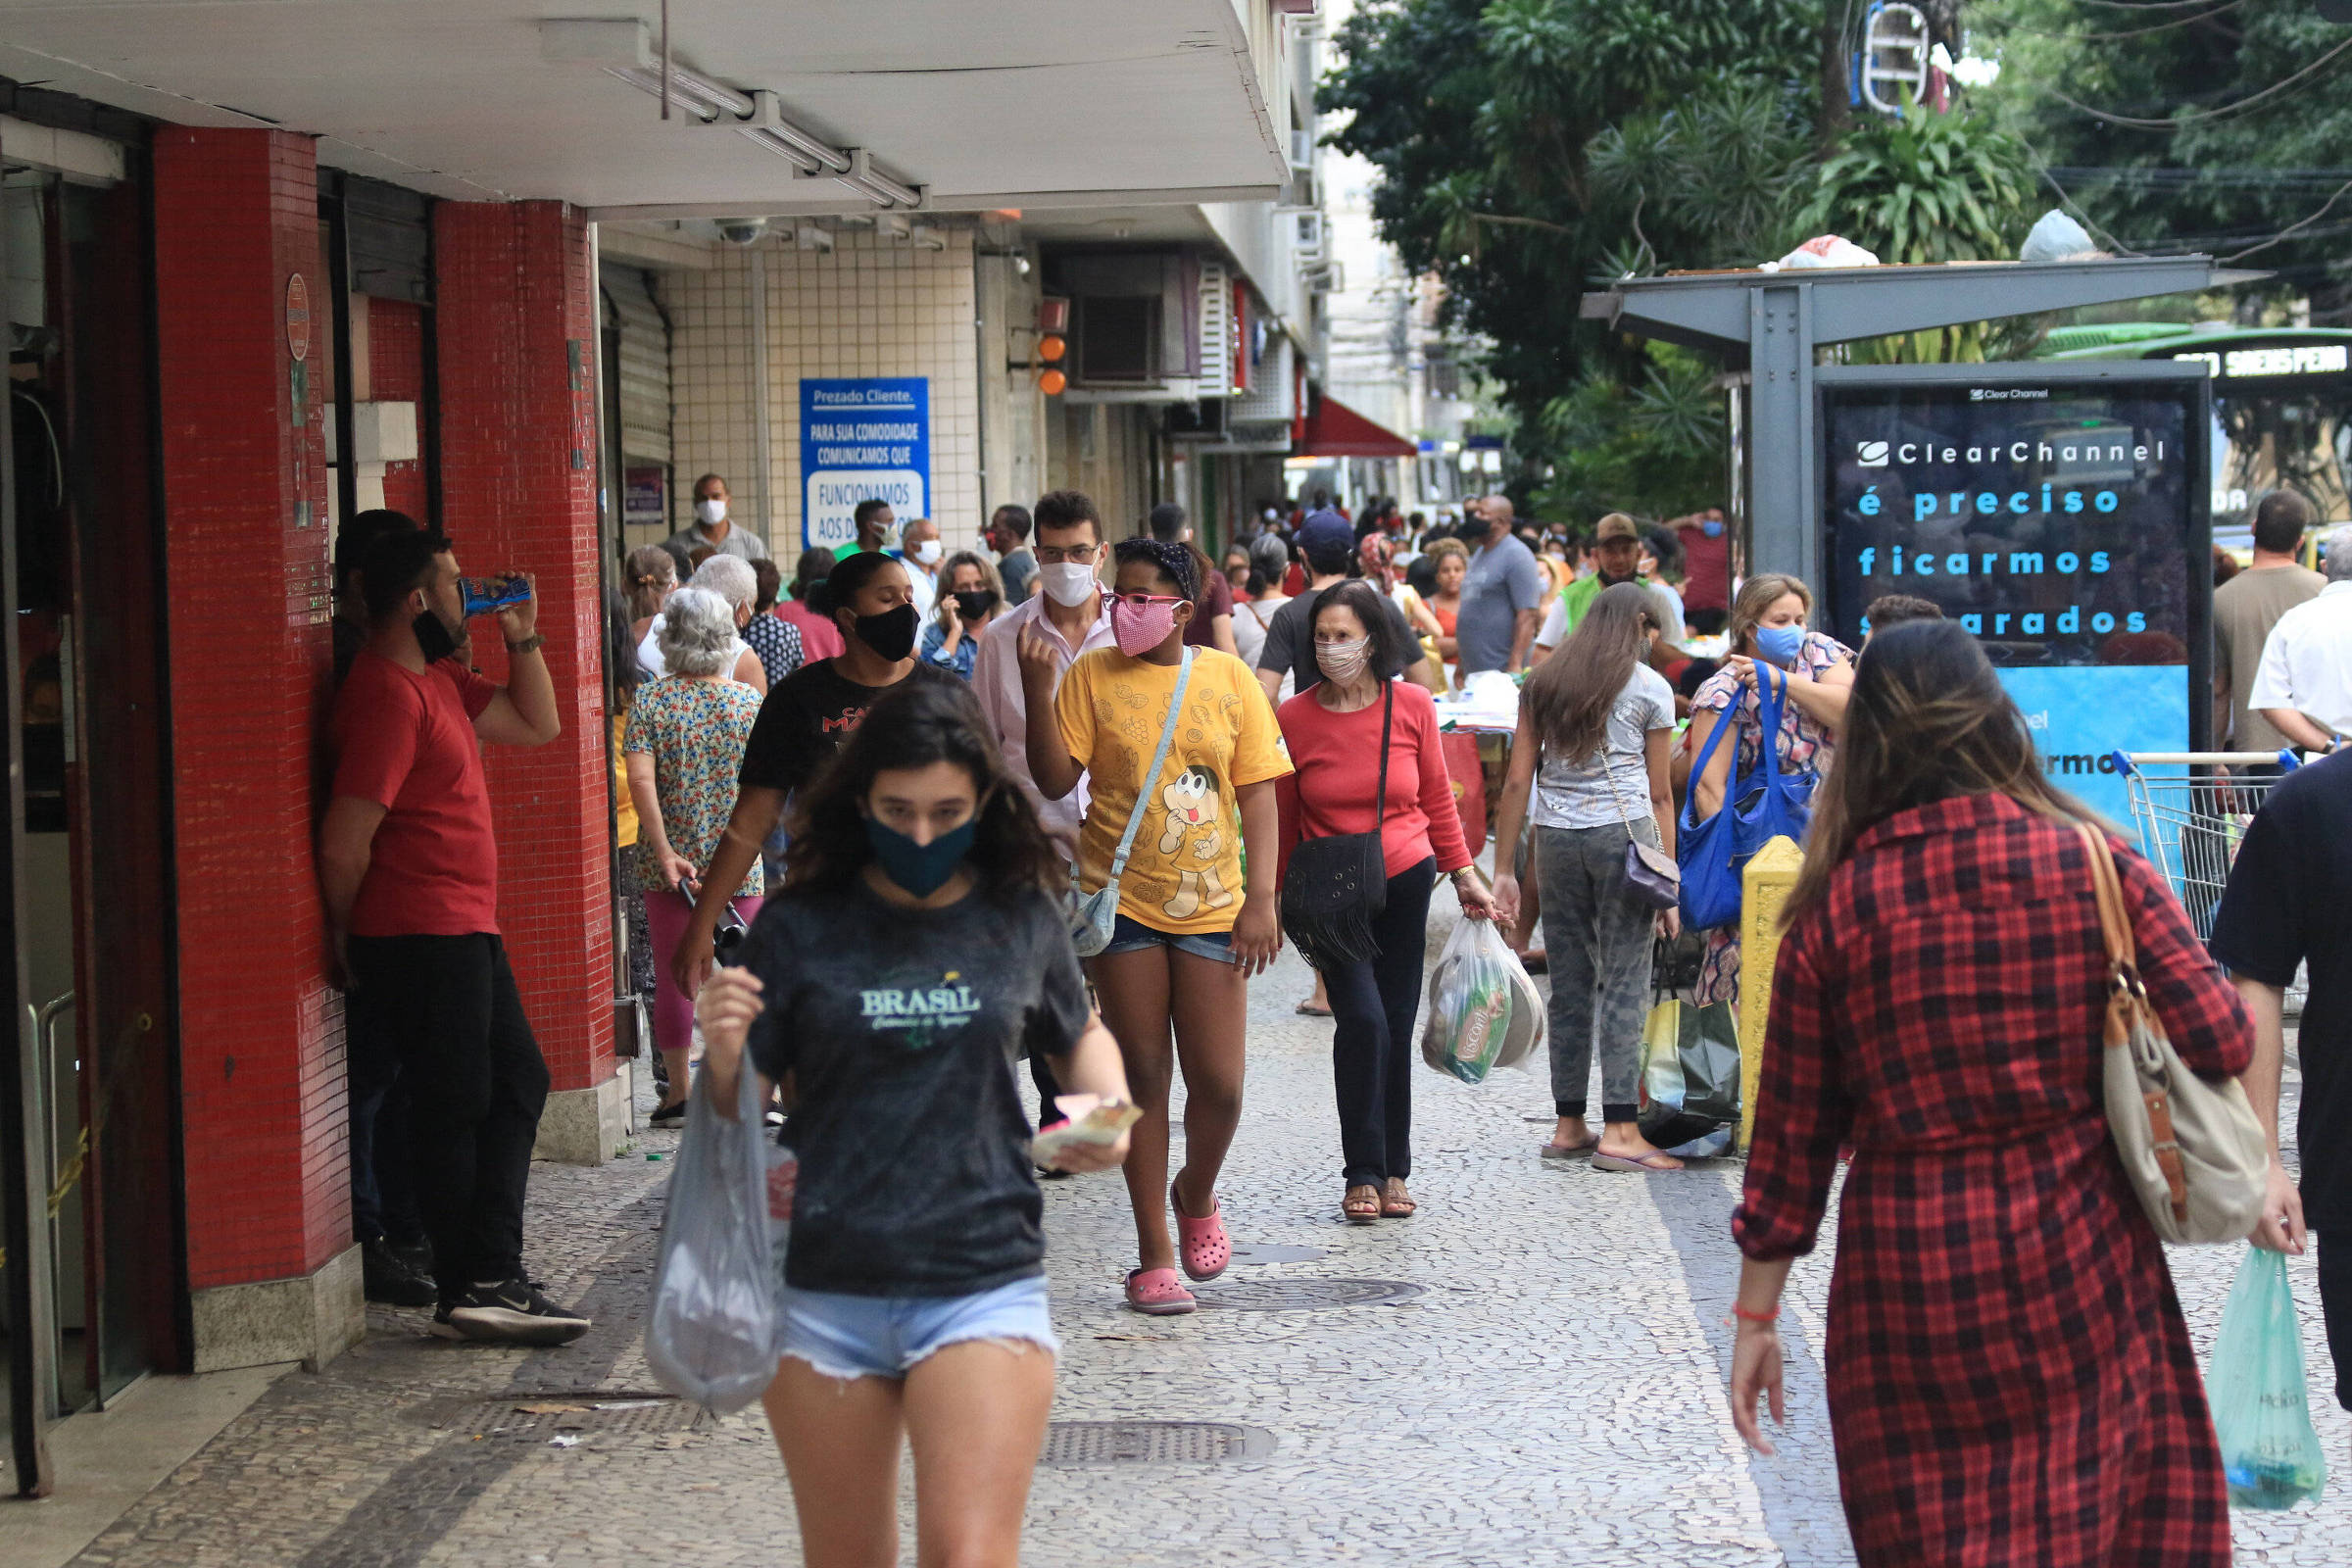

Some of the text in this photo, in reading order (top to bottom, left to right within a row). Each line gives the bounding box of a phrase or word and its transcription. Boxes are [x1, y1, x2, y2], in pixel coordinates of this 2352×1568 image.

[813, 390, 863, 403] Prezado
[810, 423, 918, 441] PARA SUA COMODIDADE
[817, 447, 911, 466] COMUNICAMOS QUE
[819, 483, 909, 506] FUNCIONAMOS
[1859, 483, 2118, 521] é preciso
[818, 516, 841, 539] AOS
[1859, 546, 2110, 575] ficarmos
[860, 986, 981, 1016] BRASIL
